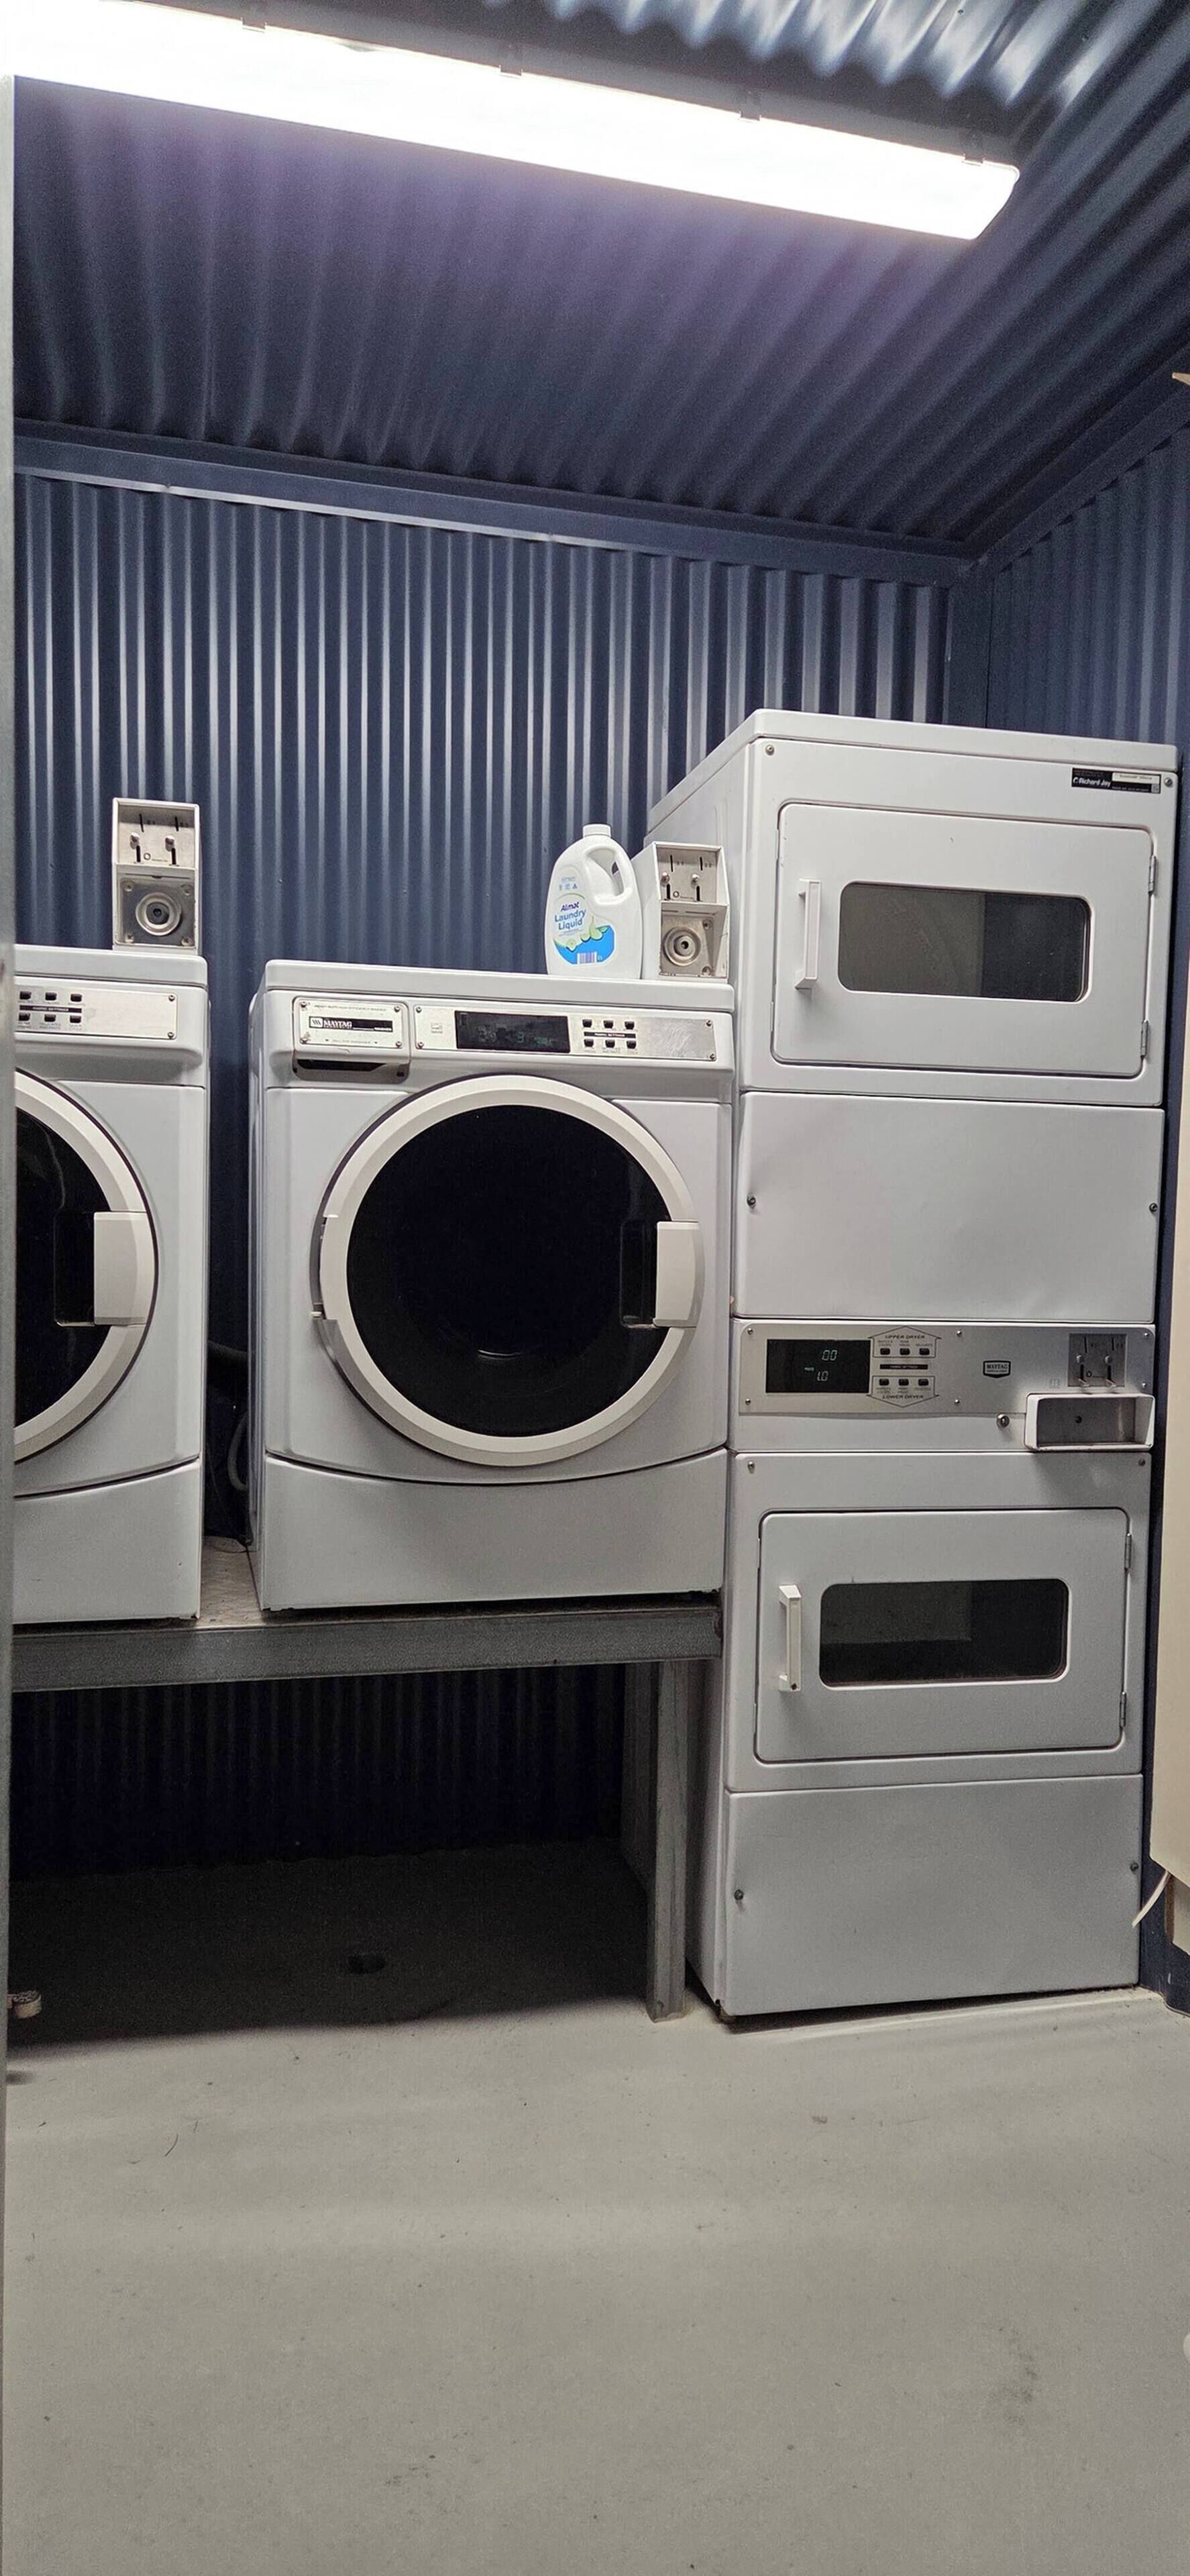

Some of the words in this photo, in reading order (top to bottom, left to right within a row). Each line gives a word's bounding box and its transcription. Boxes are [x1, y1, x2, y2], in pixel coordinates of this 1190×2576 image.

[555, 909, 586, 922] Laundry
[558, 918, 583, 930] Liquid
[323, 1020, 352, 1028] MAYTAG
